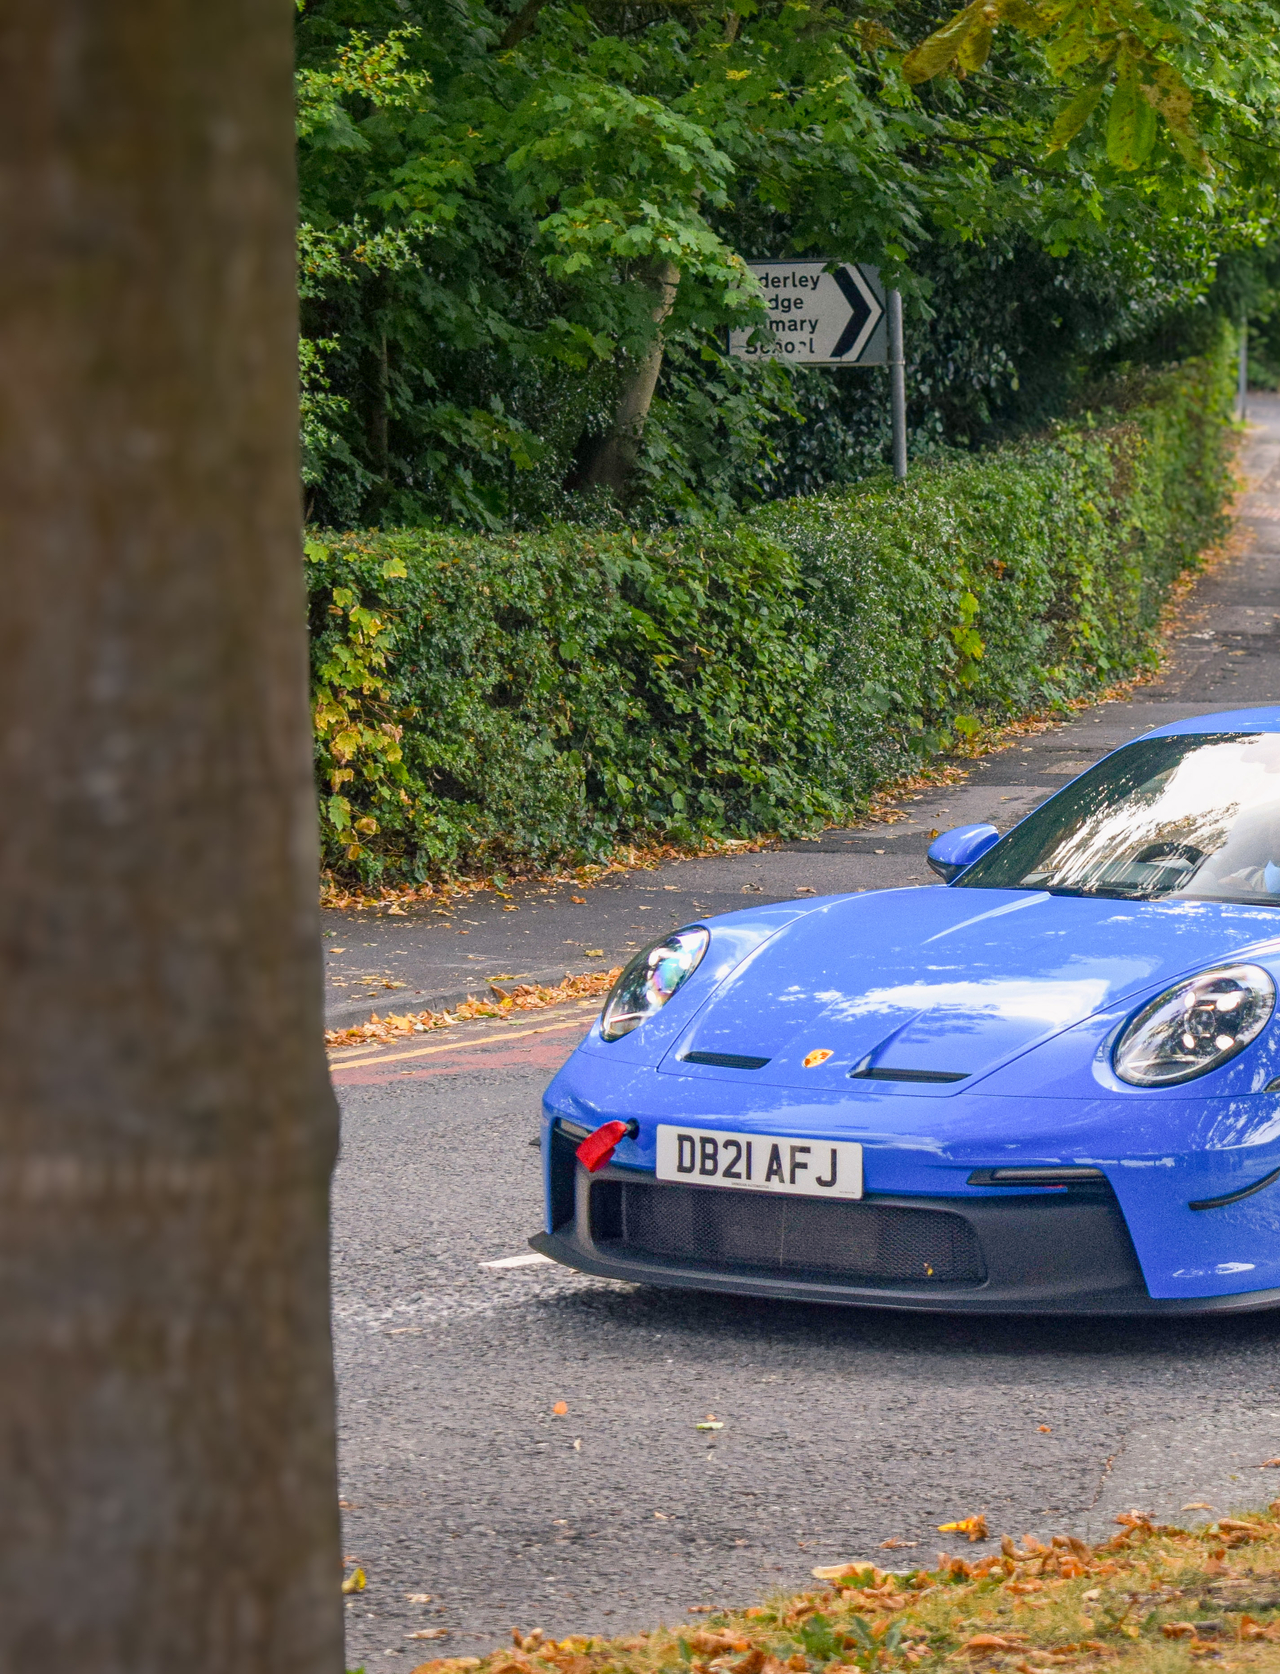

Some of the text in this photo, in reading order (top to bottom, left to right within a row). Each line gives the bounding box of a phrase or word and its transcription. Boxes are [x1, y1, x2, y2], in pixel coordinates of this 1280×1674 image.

[745, 271, 821, 291] derley
[757, 293, 804, 314] dge
[746, 318, 819, 335] mary
[676, 1133, 838, 1188] DB21 AFJ
